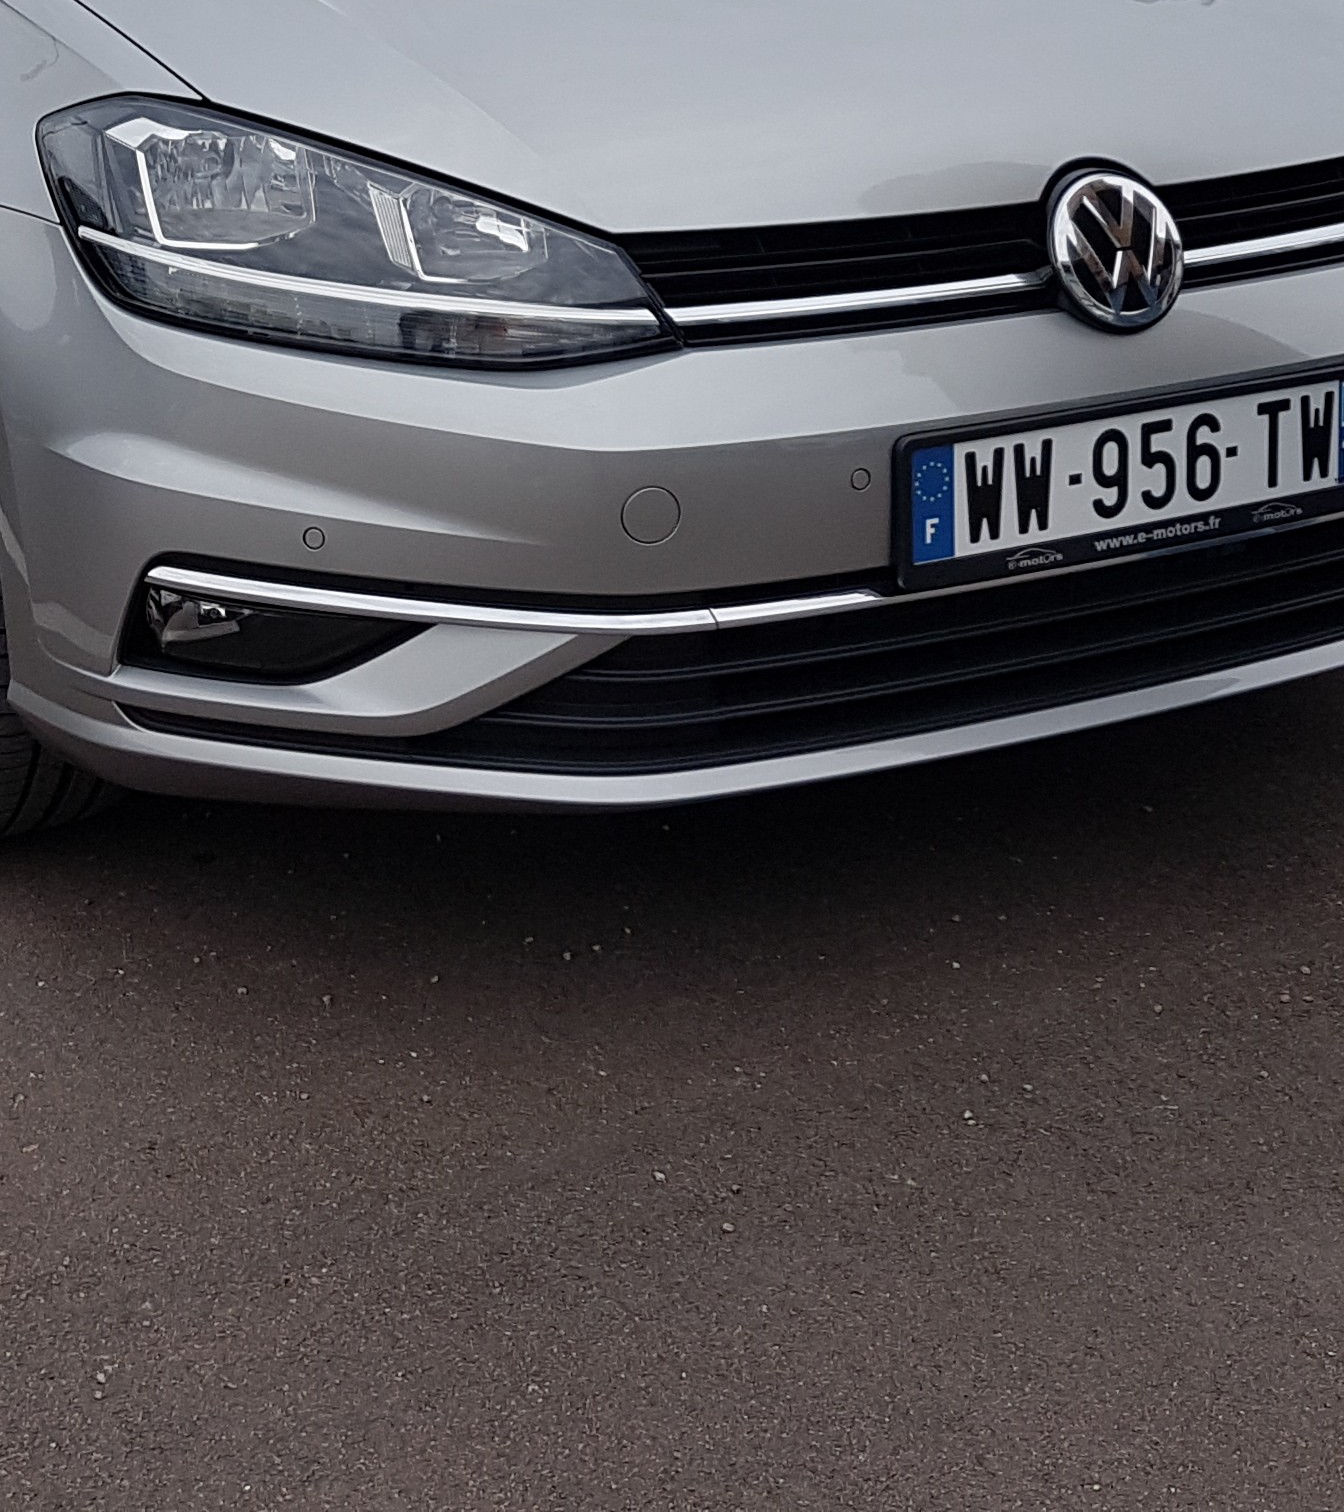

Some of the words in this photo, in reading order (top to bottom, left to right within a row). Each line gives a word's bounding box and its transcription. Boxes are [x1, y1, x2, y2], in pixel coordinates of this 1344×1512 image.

[964, 390, 1335, 544] WW-956-TW
[924, 517, 939, 545] F
[1094, 515, 1222, 553] www.e-motors.fr
